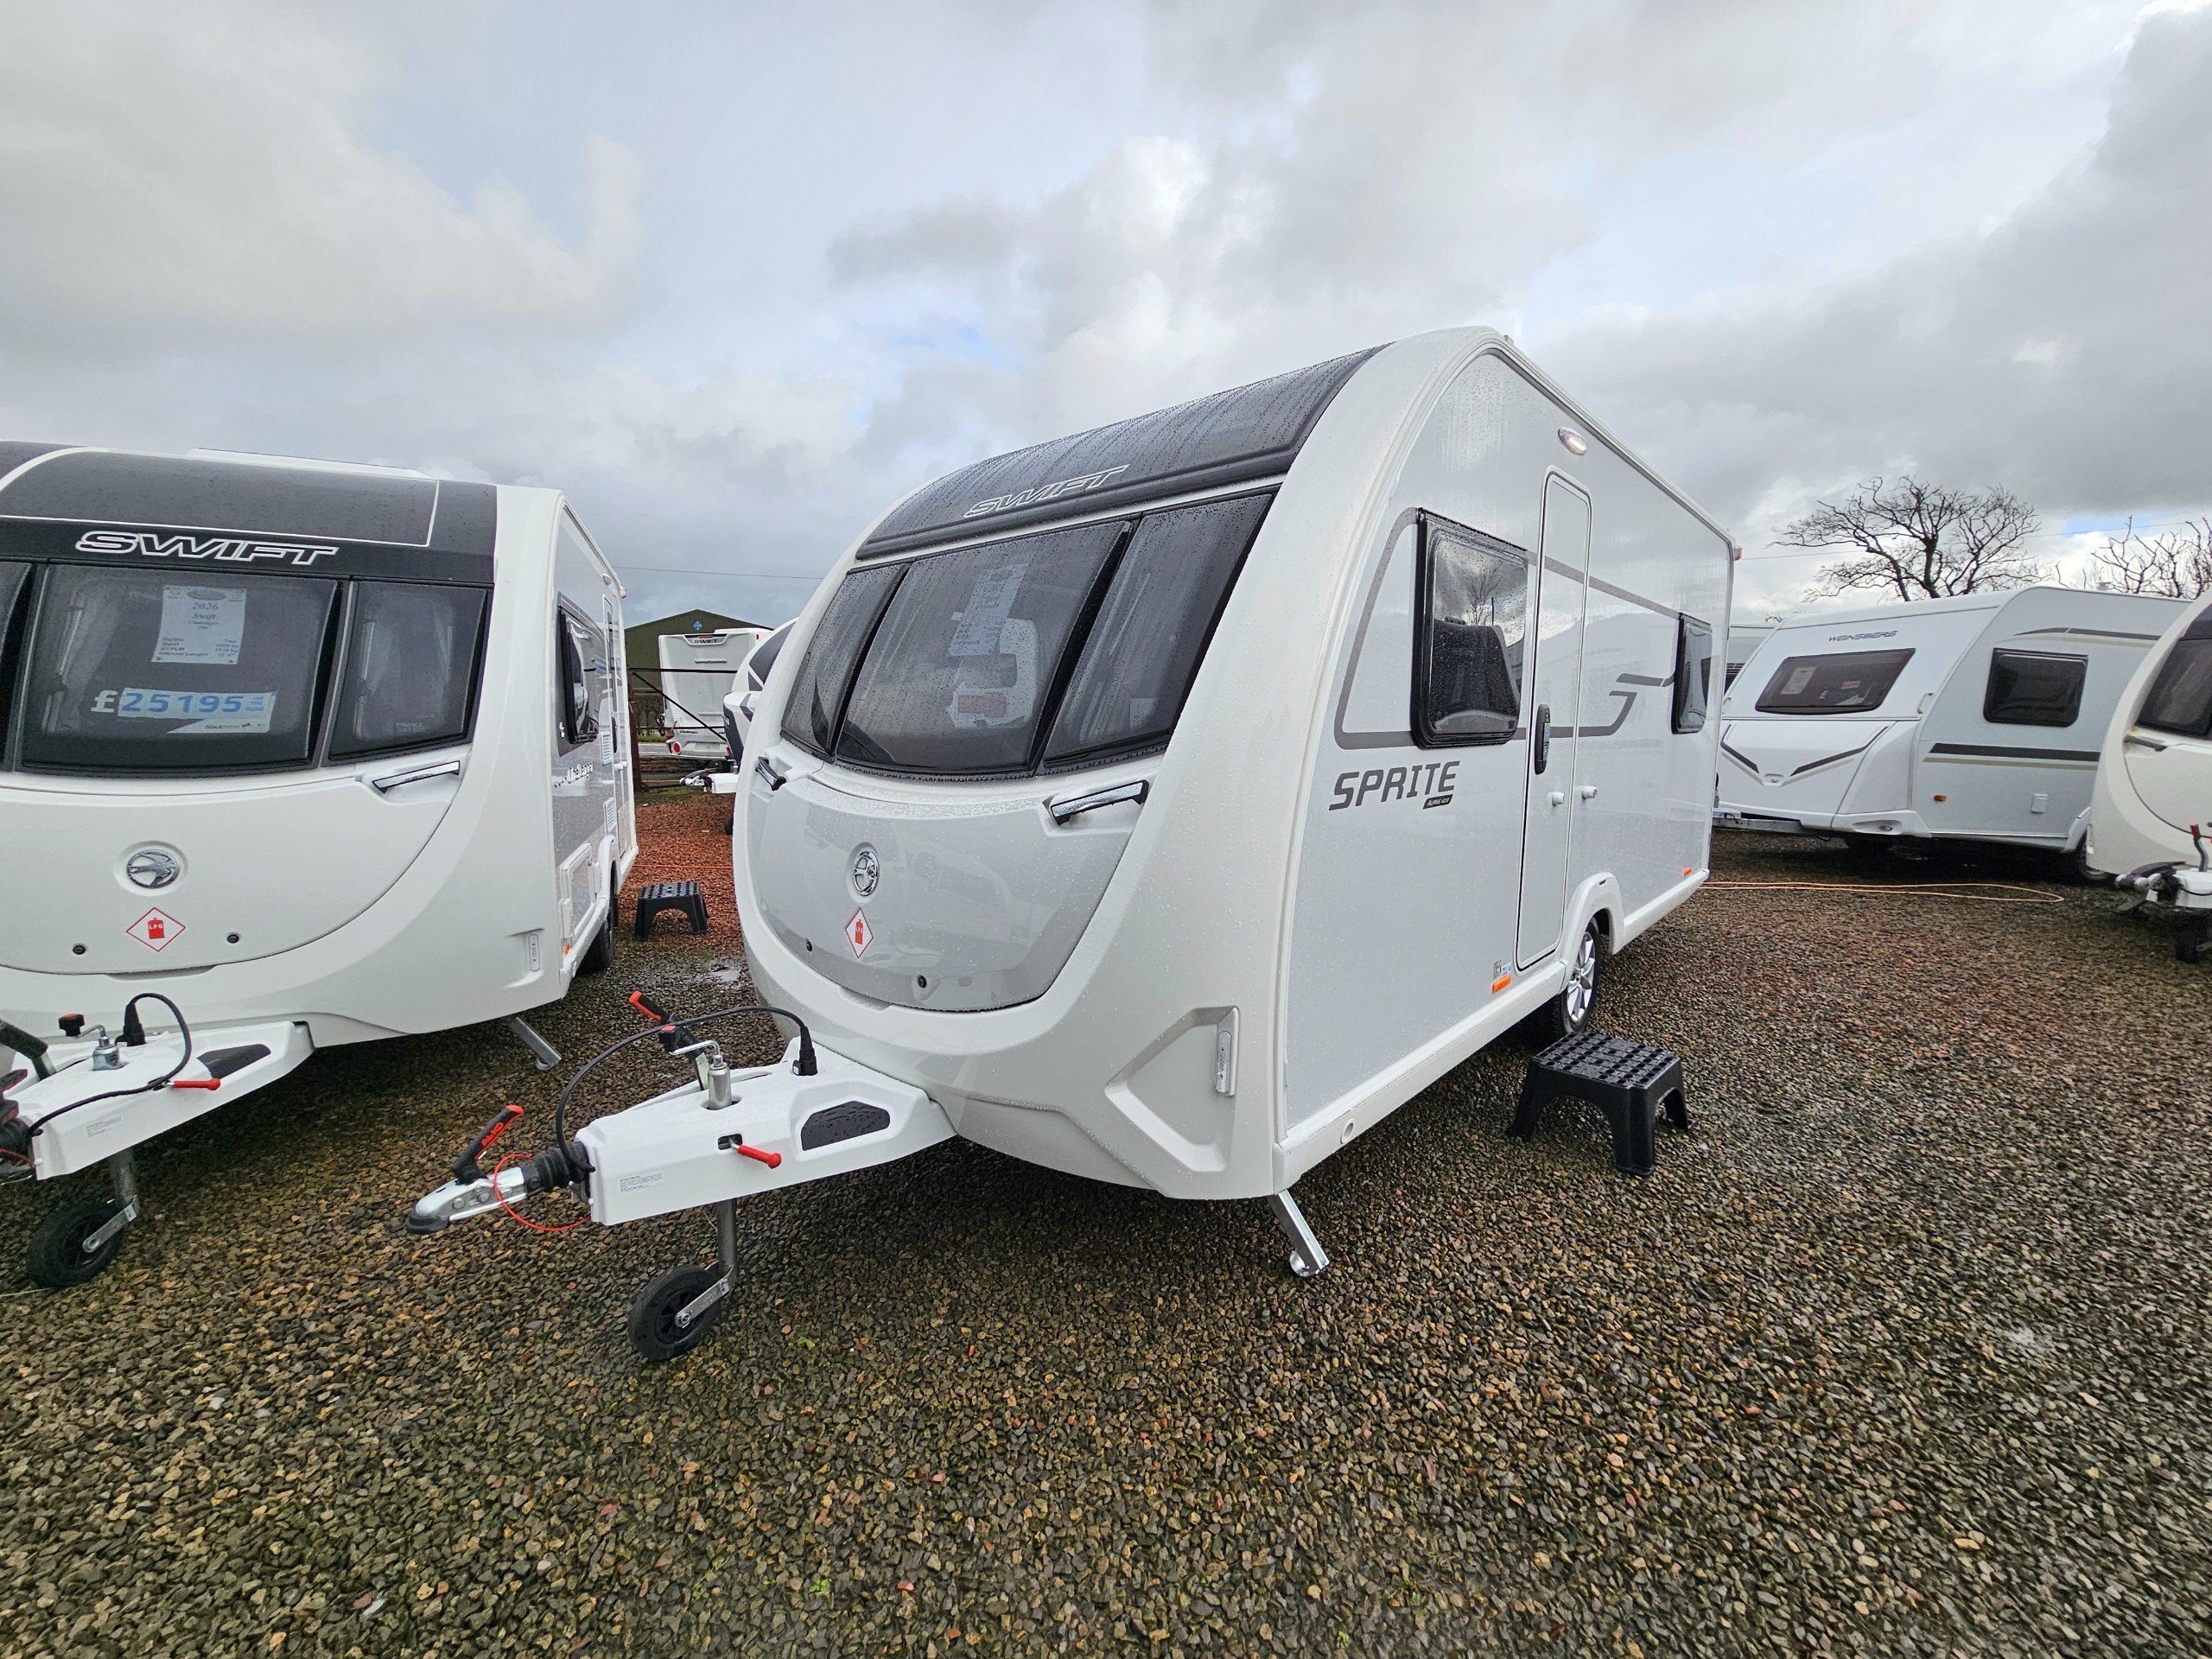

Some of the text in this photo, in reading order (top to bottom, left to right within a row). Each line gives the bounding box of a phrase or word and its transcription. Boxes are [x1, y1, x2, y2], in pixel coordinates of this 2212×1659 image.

[963, 464, 1131, 518] SWIFT
[75, 531, 340, 566] SWIFT
[1827, 630, 1899, 642] WEINSBERG
[1328, 760, 1461, 811] SPRITE
